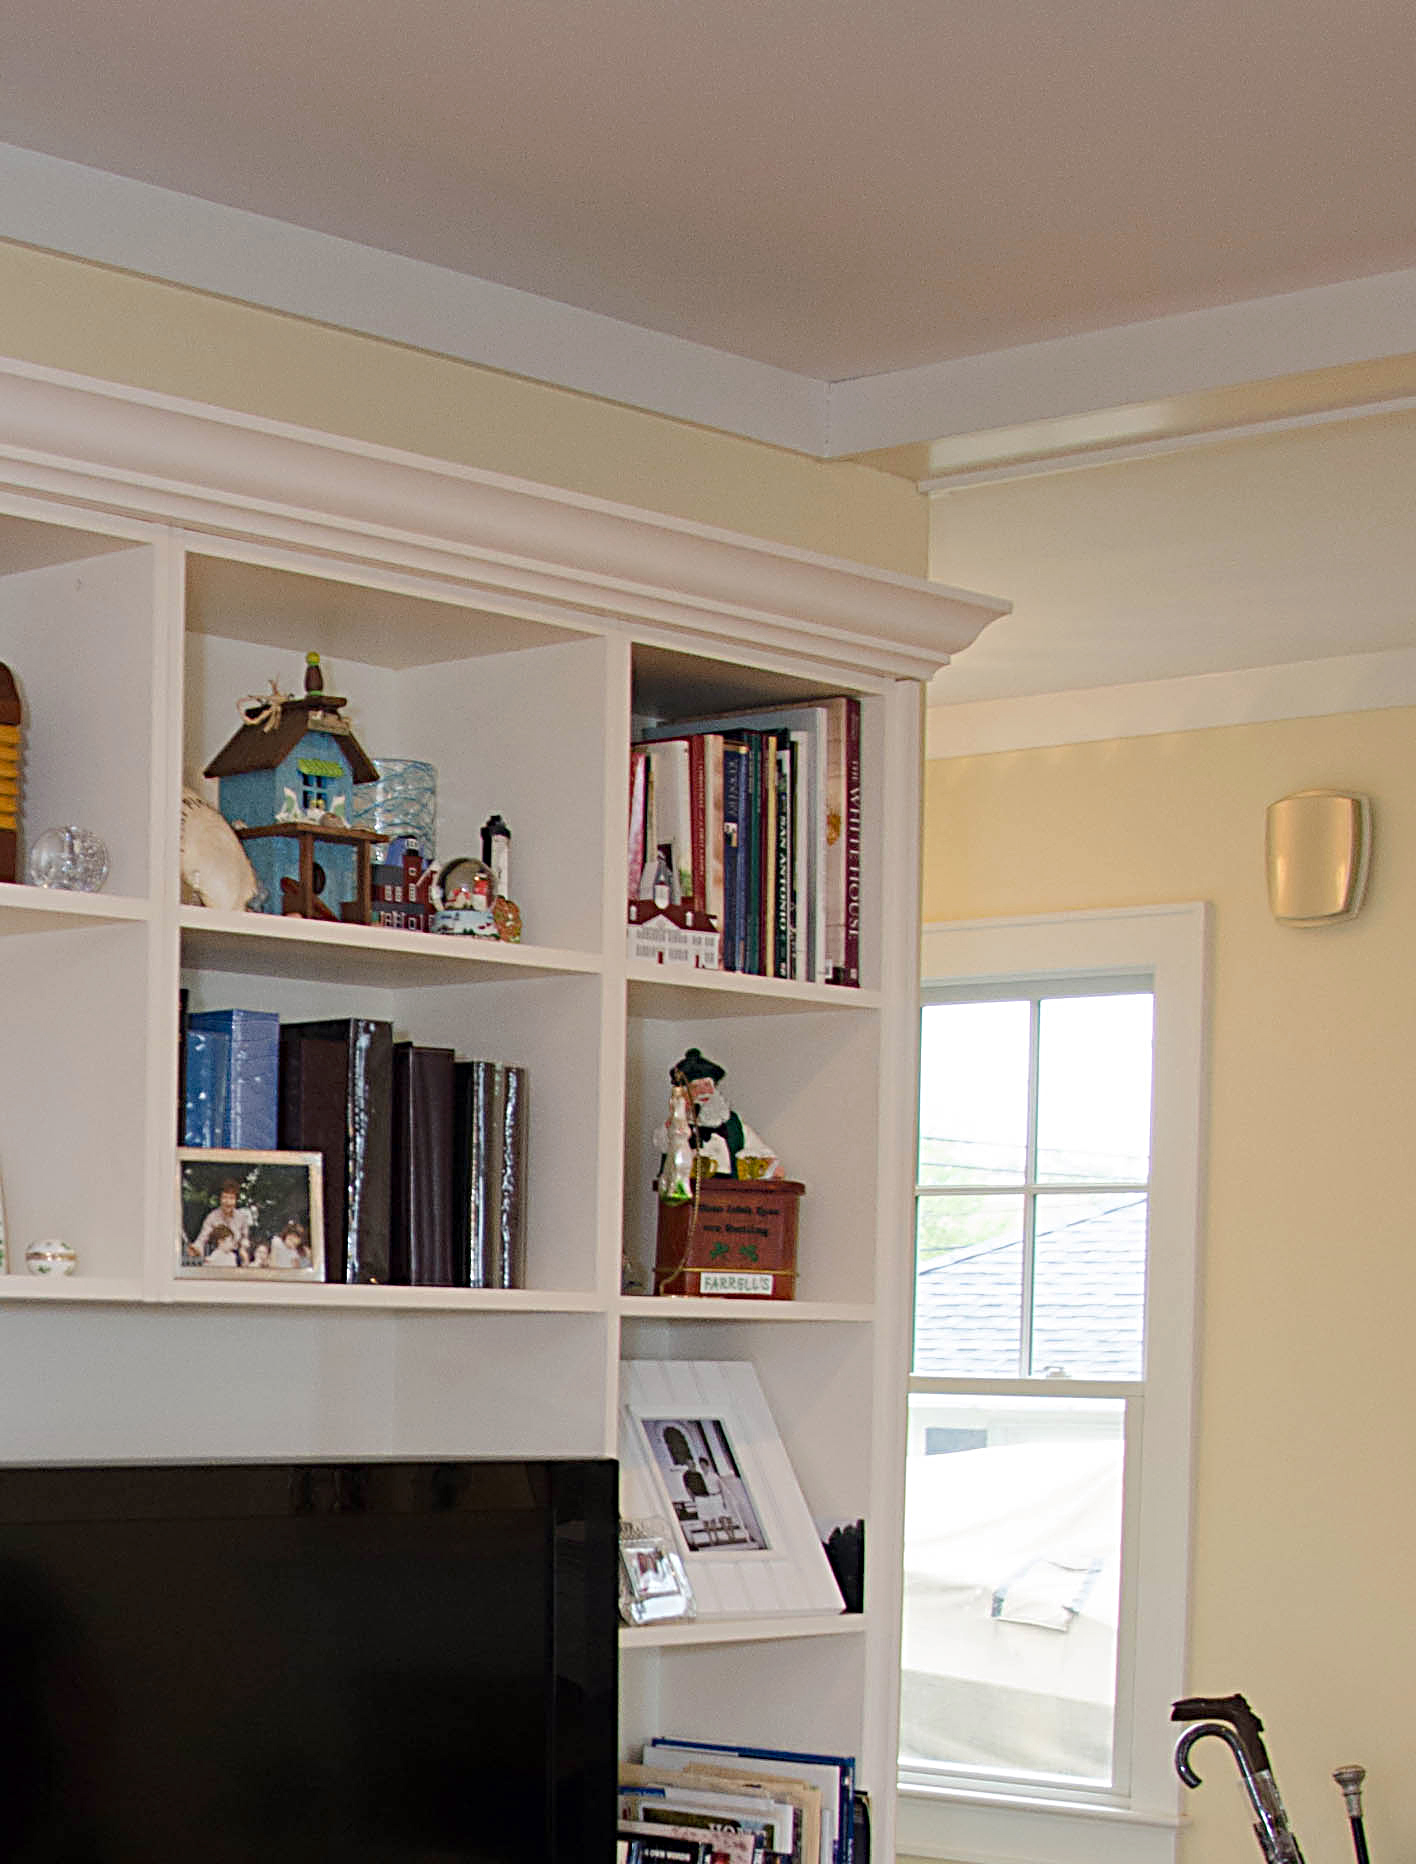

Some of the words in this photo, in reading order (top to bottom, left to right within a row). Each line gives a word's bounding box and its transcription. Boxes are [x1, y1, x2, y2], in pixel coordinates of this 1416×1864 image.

[779, 815, 788, 849] SAN
[849, 786, 861, 855] WHITE
[779, 852, 788, 931] ANTONIO
[848, 866, 861, 939] HOUSE
[705, 1277, 770, 1291] FARRELL'S
